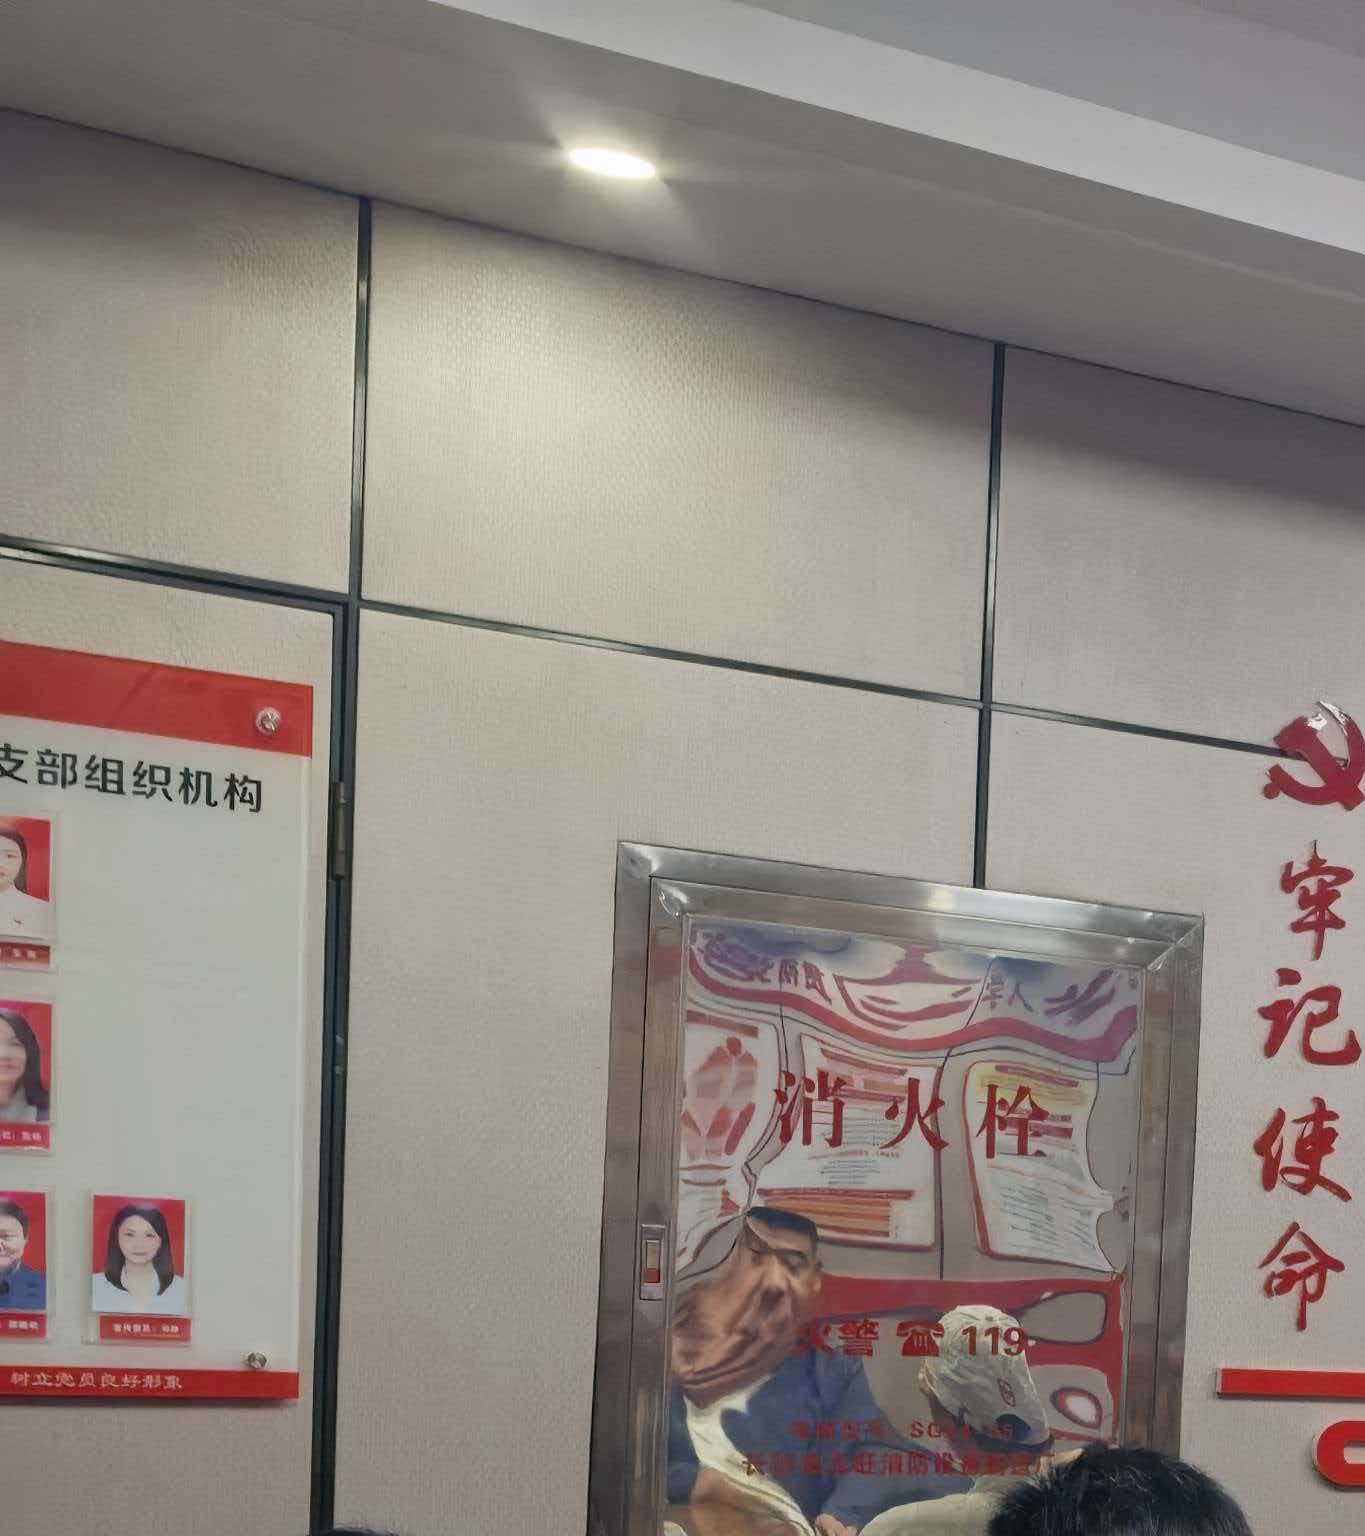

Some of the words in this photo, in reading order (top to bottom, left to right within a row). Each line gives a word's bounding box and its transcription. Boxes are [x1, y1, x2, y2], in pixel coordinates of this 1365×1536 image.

[773, 1069, 1051, 1159] 消火栓
[1254, 840, 1361, 1332] 牢记使命
[961, 1326, 1026, 1356] 119
